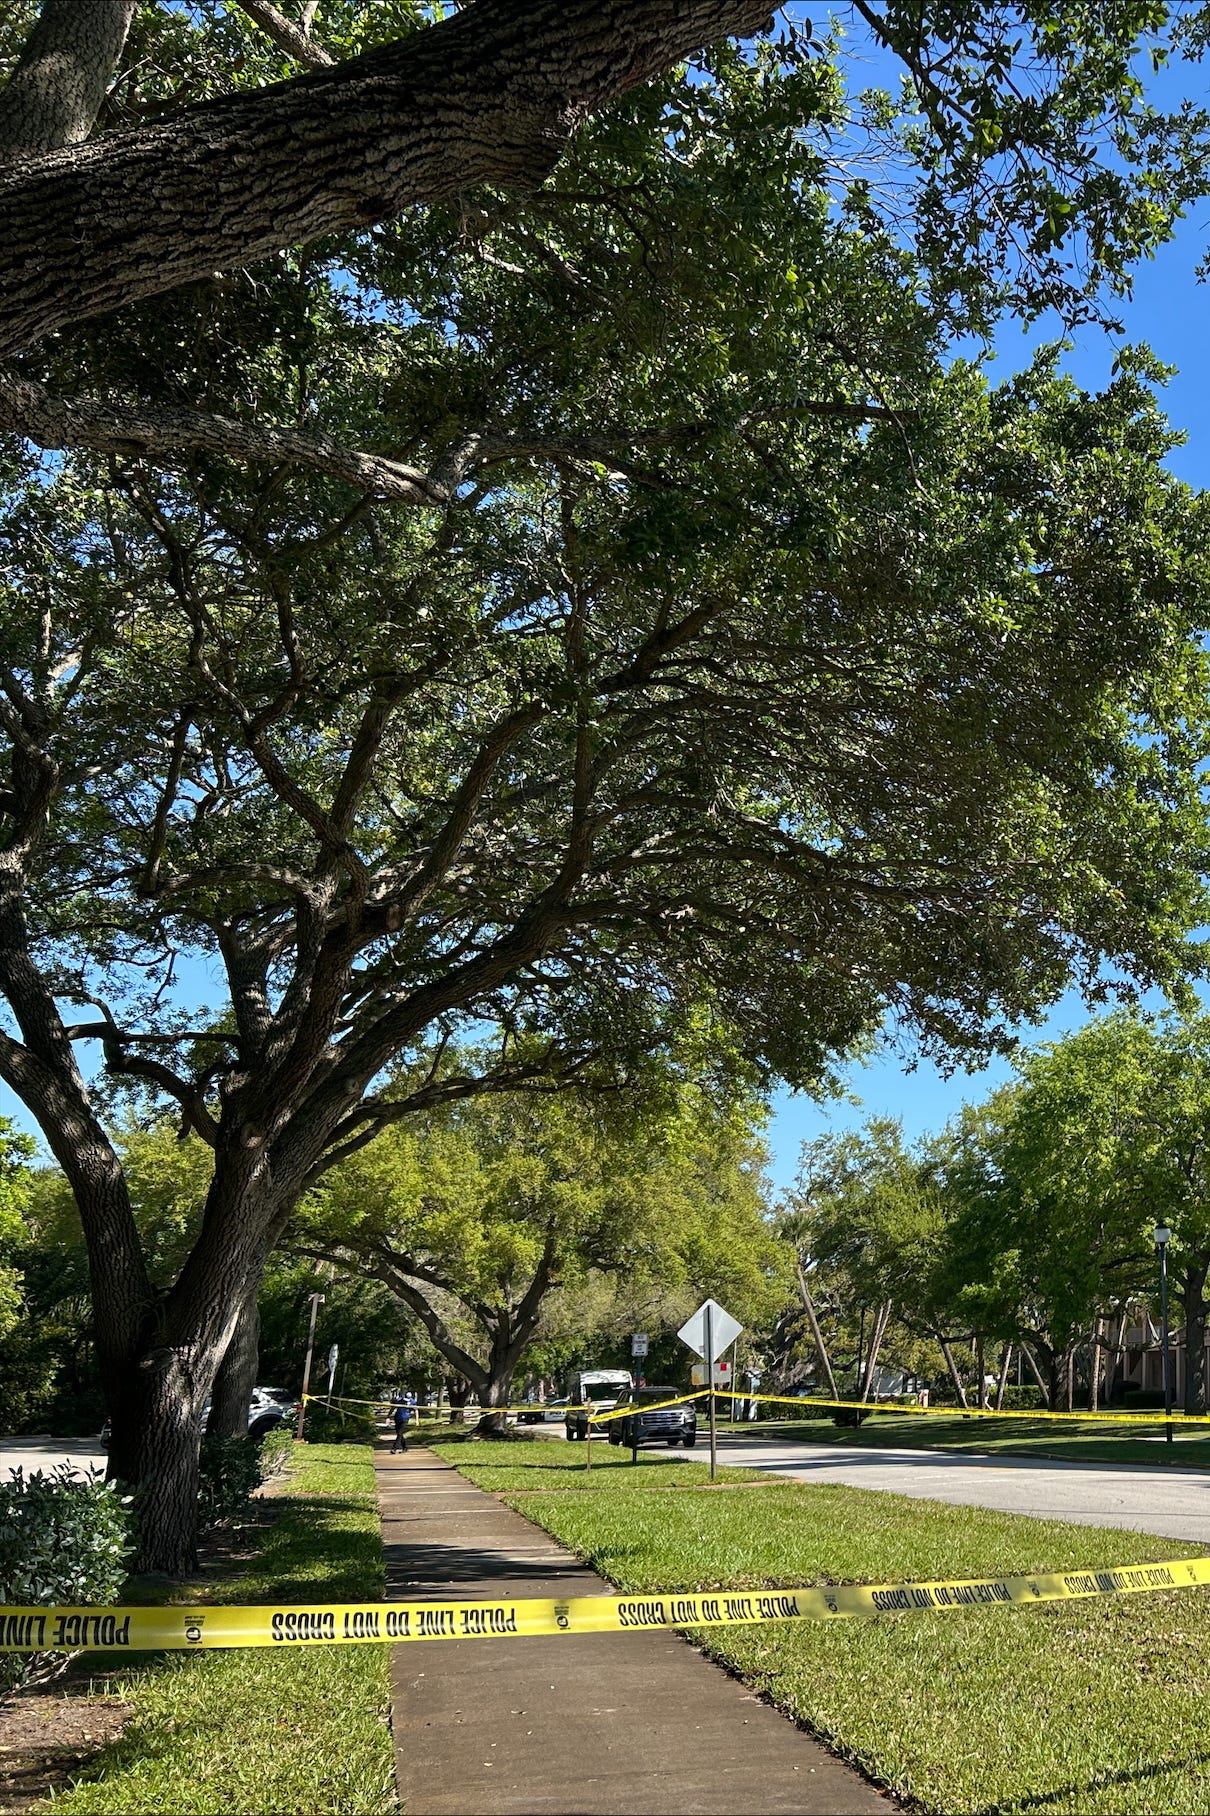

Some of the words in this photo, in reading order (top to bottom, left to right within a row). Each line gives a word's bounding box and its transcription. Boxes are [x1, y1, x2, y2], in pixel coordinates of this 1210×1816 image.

[1064, 1575, 1096, 1594] CROSS
[1094, 1573, 1116, 1591] NOT
[1113, 1572, 1128, 1589] DO
[1126, 1570, 1148, 1587] LINE
[1145, 1567, 1174, 1586] POLICE
[872, 1589, 911, 1611] CROSS
[911, 1588, 936, 1608] NOT
[934, 1587, 953, 1605] DO
[950, 1585, 978, 1604] LINE
[975, 1583, 1012, 1602] POLICE
[618, 1602, 667, 1626] CROSS
[671, 1600, 700, 1624] NOT
[702, 1600, 722, 1621] DO
[723, 1598, 755, 1620] LINE
[755, 1596, 801, 1618] POLICE
[53, 1615, 131, 1646] POLICE
[272, 1612, 335, 1641] CROSS
[342, 1612, 380, 1639] NOT
[386, 1611, 411, 1637] DO
[416, 1610, 456, 1636] LINE
[460, 1608, 518, 1634] POLICE
